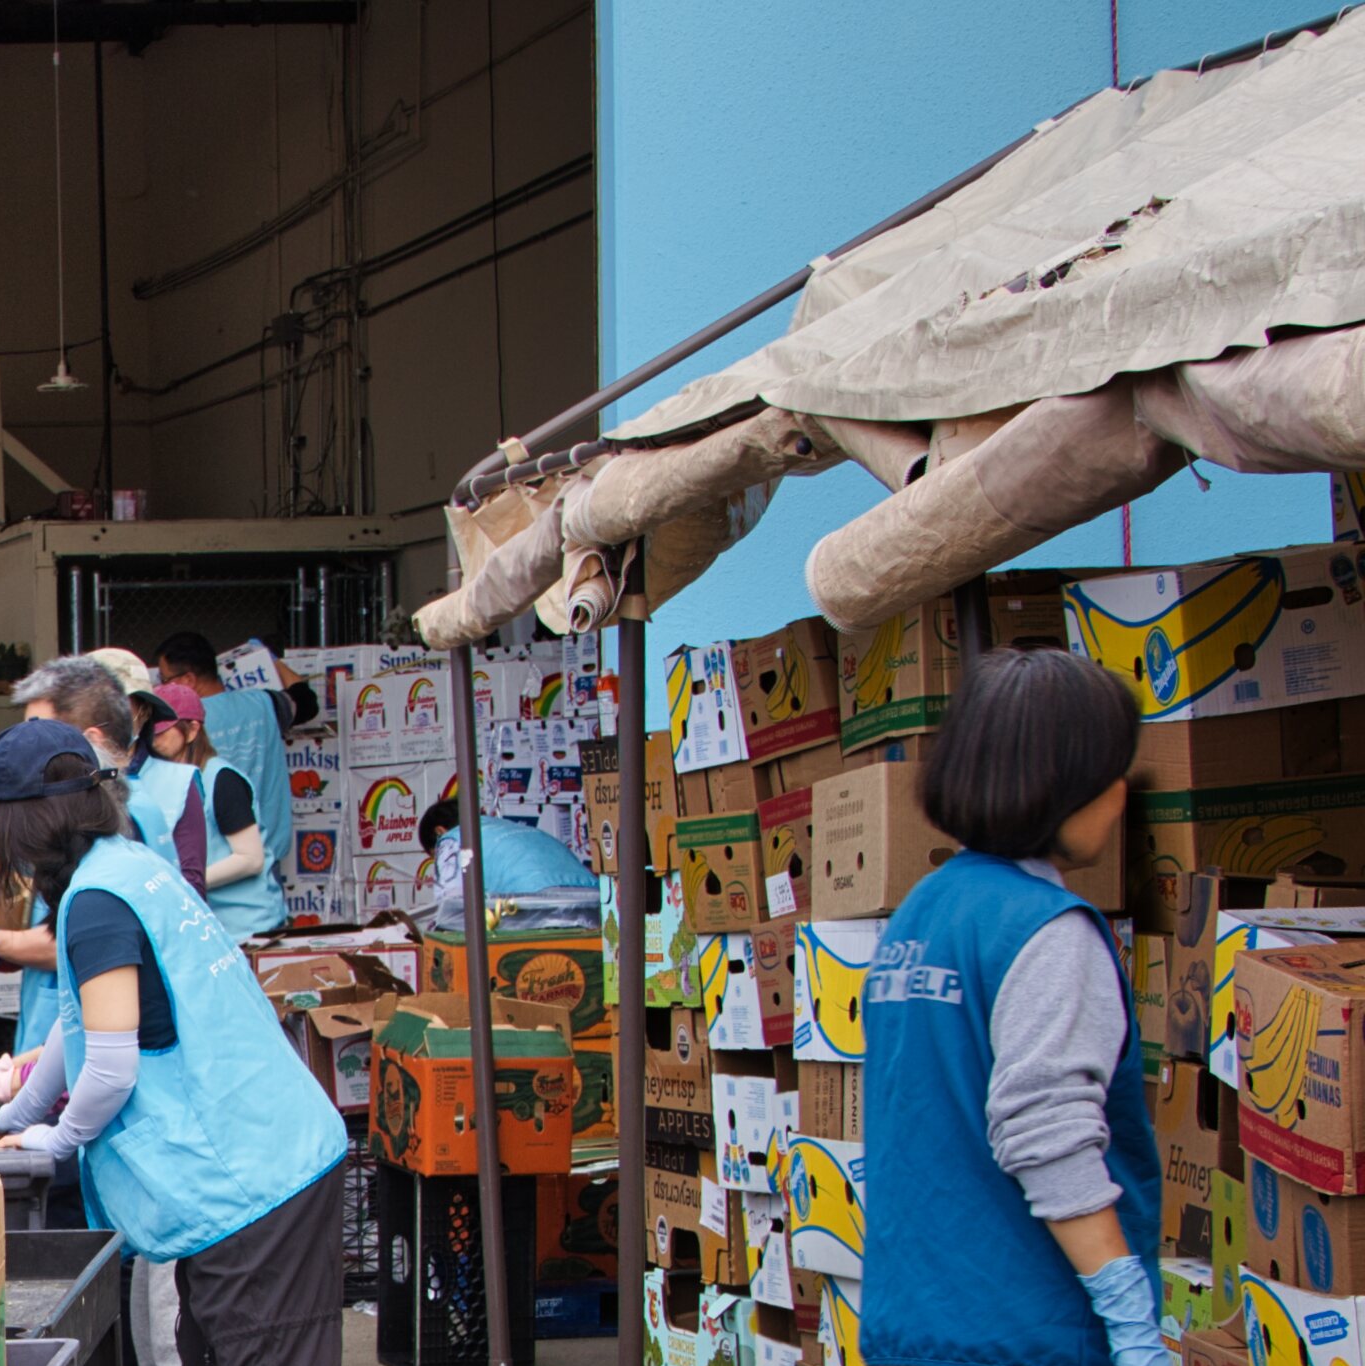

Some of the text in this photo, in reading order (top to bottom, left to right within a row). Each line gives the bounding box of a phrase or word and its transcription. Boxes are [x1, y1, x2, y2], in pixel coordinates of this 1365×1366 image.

[379, 651, 442, 671] Sunkist
[223, 667, 269, 690] kist
[286, 745, 340, 772] unkist
[582, 748, 618, 772] PPLES
[377, 812, 418, 831] Rainbow
[385, 831, 413, 842] APPLES
[287, 890, 342, 914] unkist
[645, 1072, 697, 1107] neycrisp
[849, 1063, 860, 1137] RGANIC
[657, 1111, 711, 1139] APPLES
[1165, 1143, 1213, 1203] Honey
[653, 1172, 702, 1210] neycrisp
